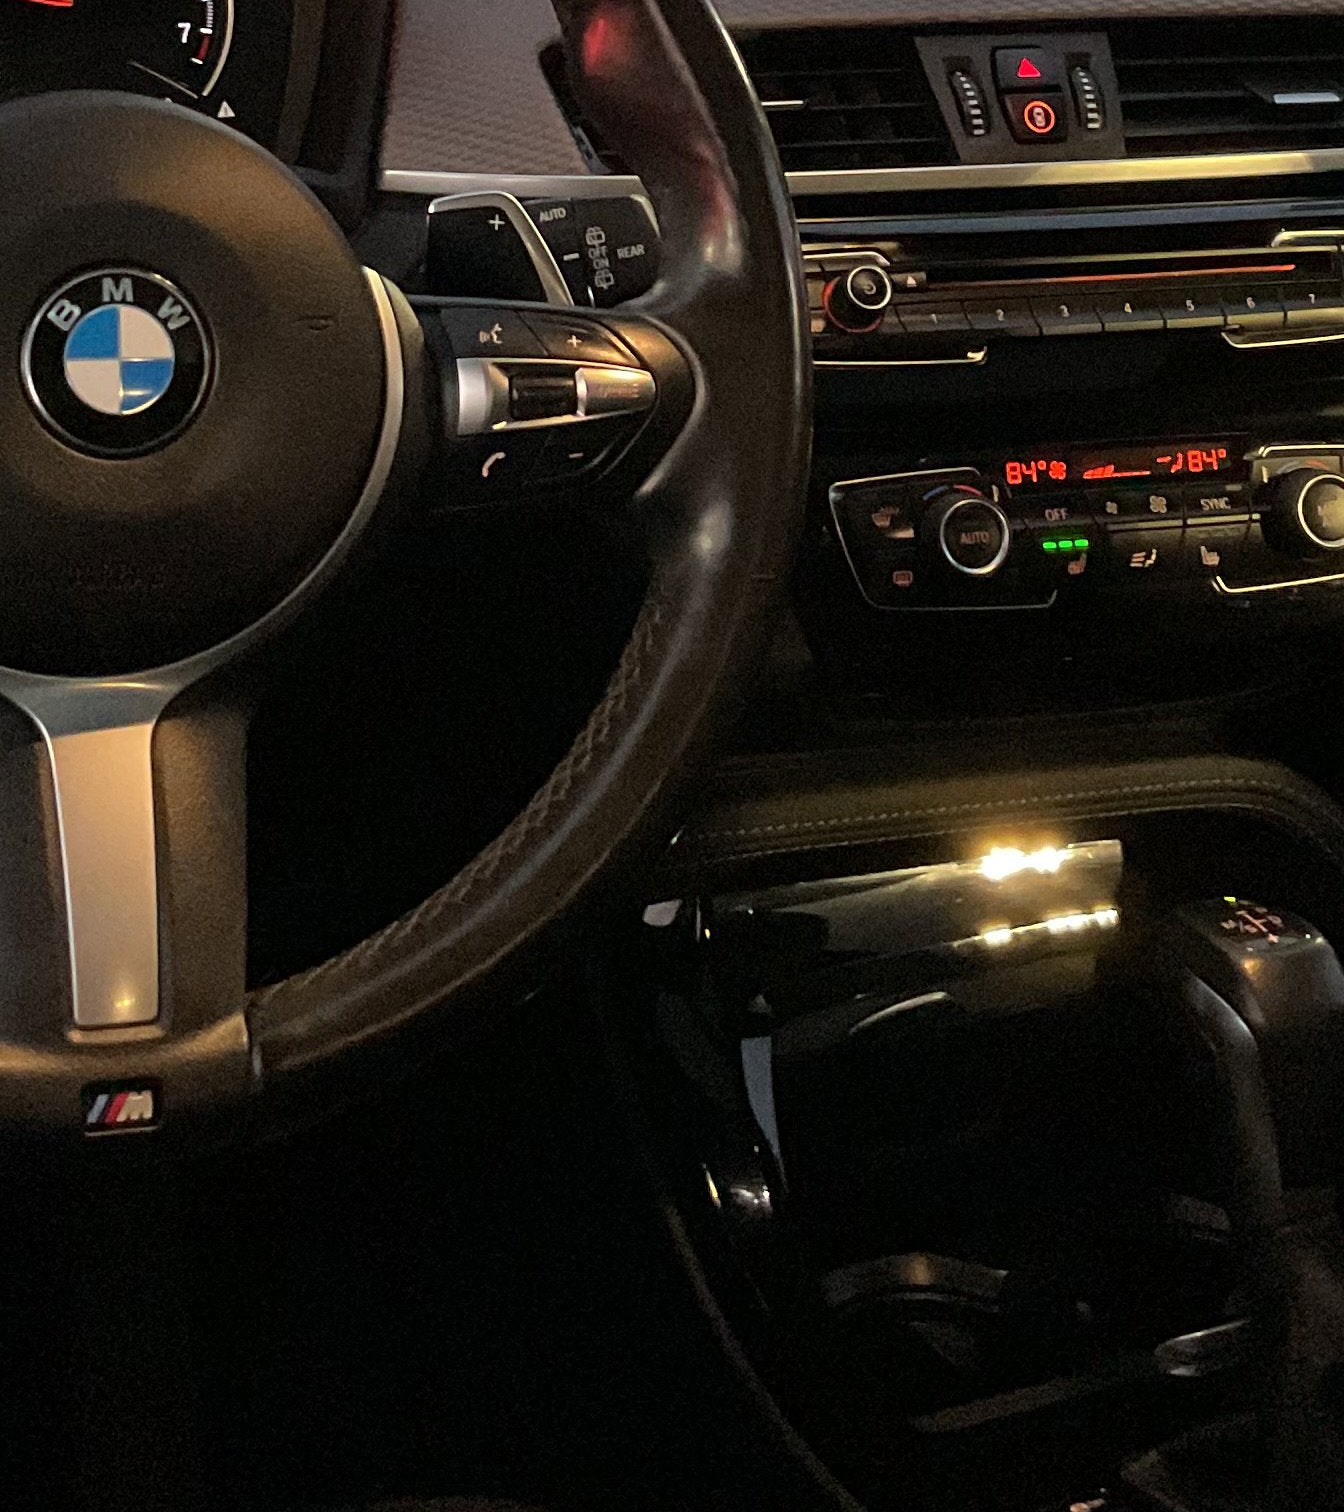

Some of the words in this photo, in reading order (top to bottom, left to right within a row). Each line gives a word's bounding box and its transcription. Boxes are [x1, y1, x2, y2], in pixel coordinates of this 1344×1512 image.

[177, 22, 192, 44] 7
[539, 207, 567, 223] AUTO
[588, 245, 608, 260] OFF
[617, 244, 646, 260] REAR
[47, 277, 191, 332] BMW
[1245, 296, 1256, 309] 6
[1308, 292, 1316, 304] 7
[1059, 304, 1070, 318] 3
[1123, 302, 1133, 314] 4
[1185, 299, 1195, 312] 5
[930, 312, 938, 325] 1
[995, 308, 1005, 322] 2
[1200, 497, 1232, 511] SYNC
[1044, 507, 1068, 522] OFF
[960, 530, 989, 545] AUTO
